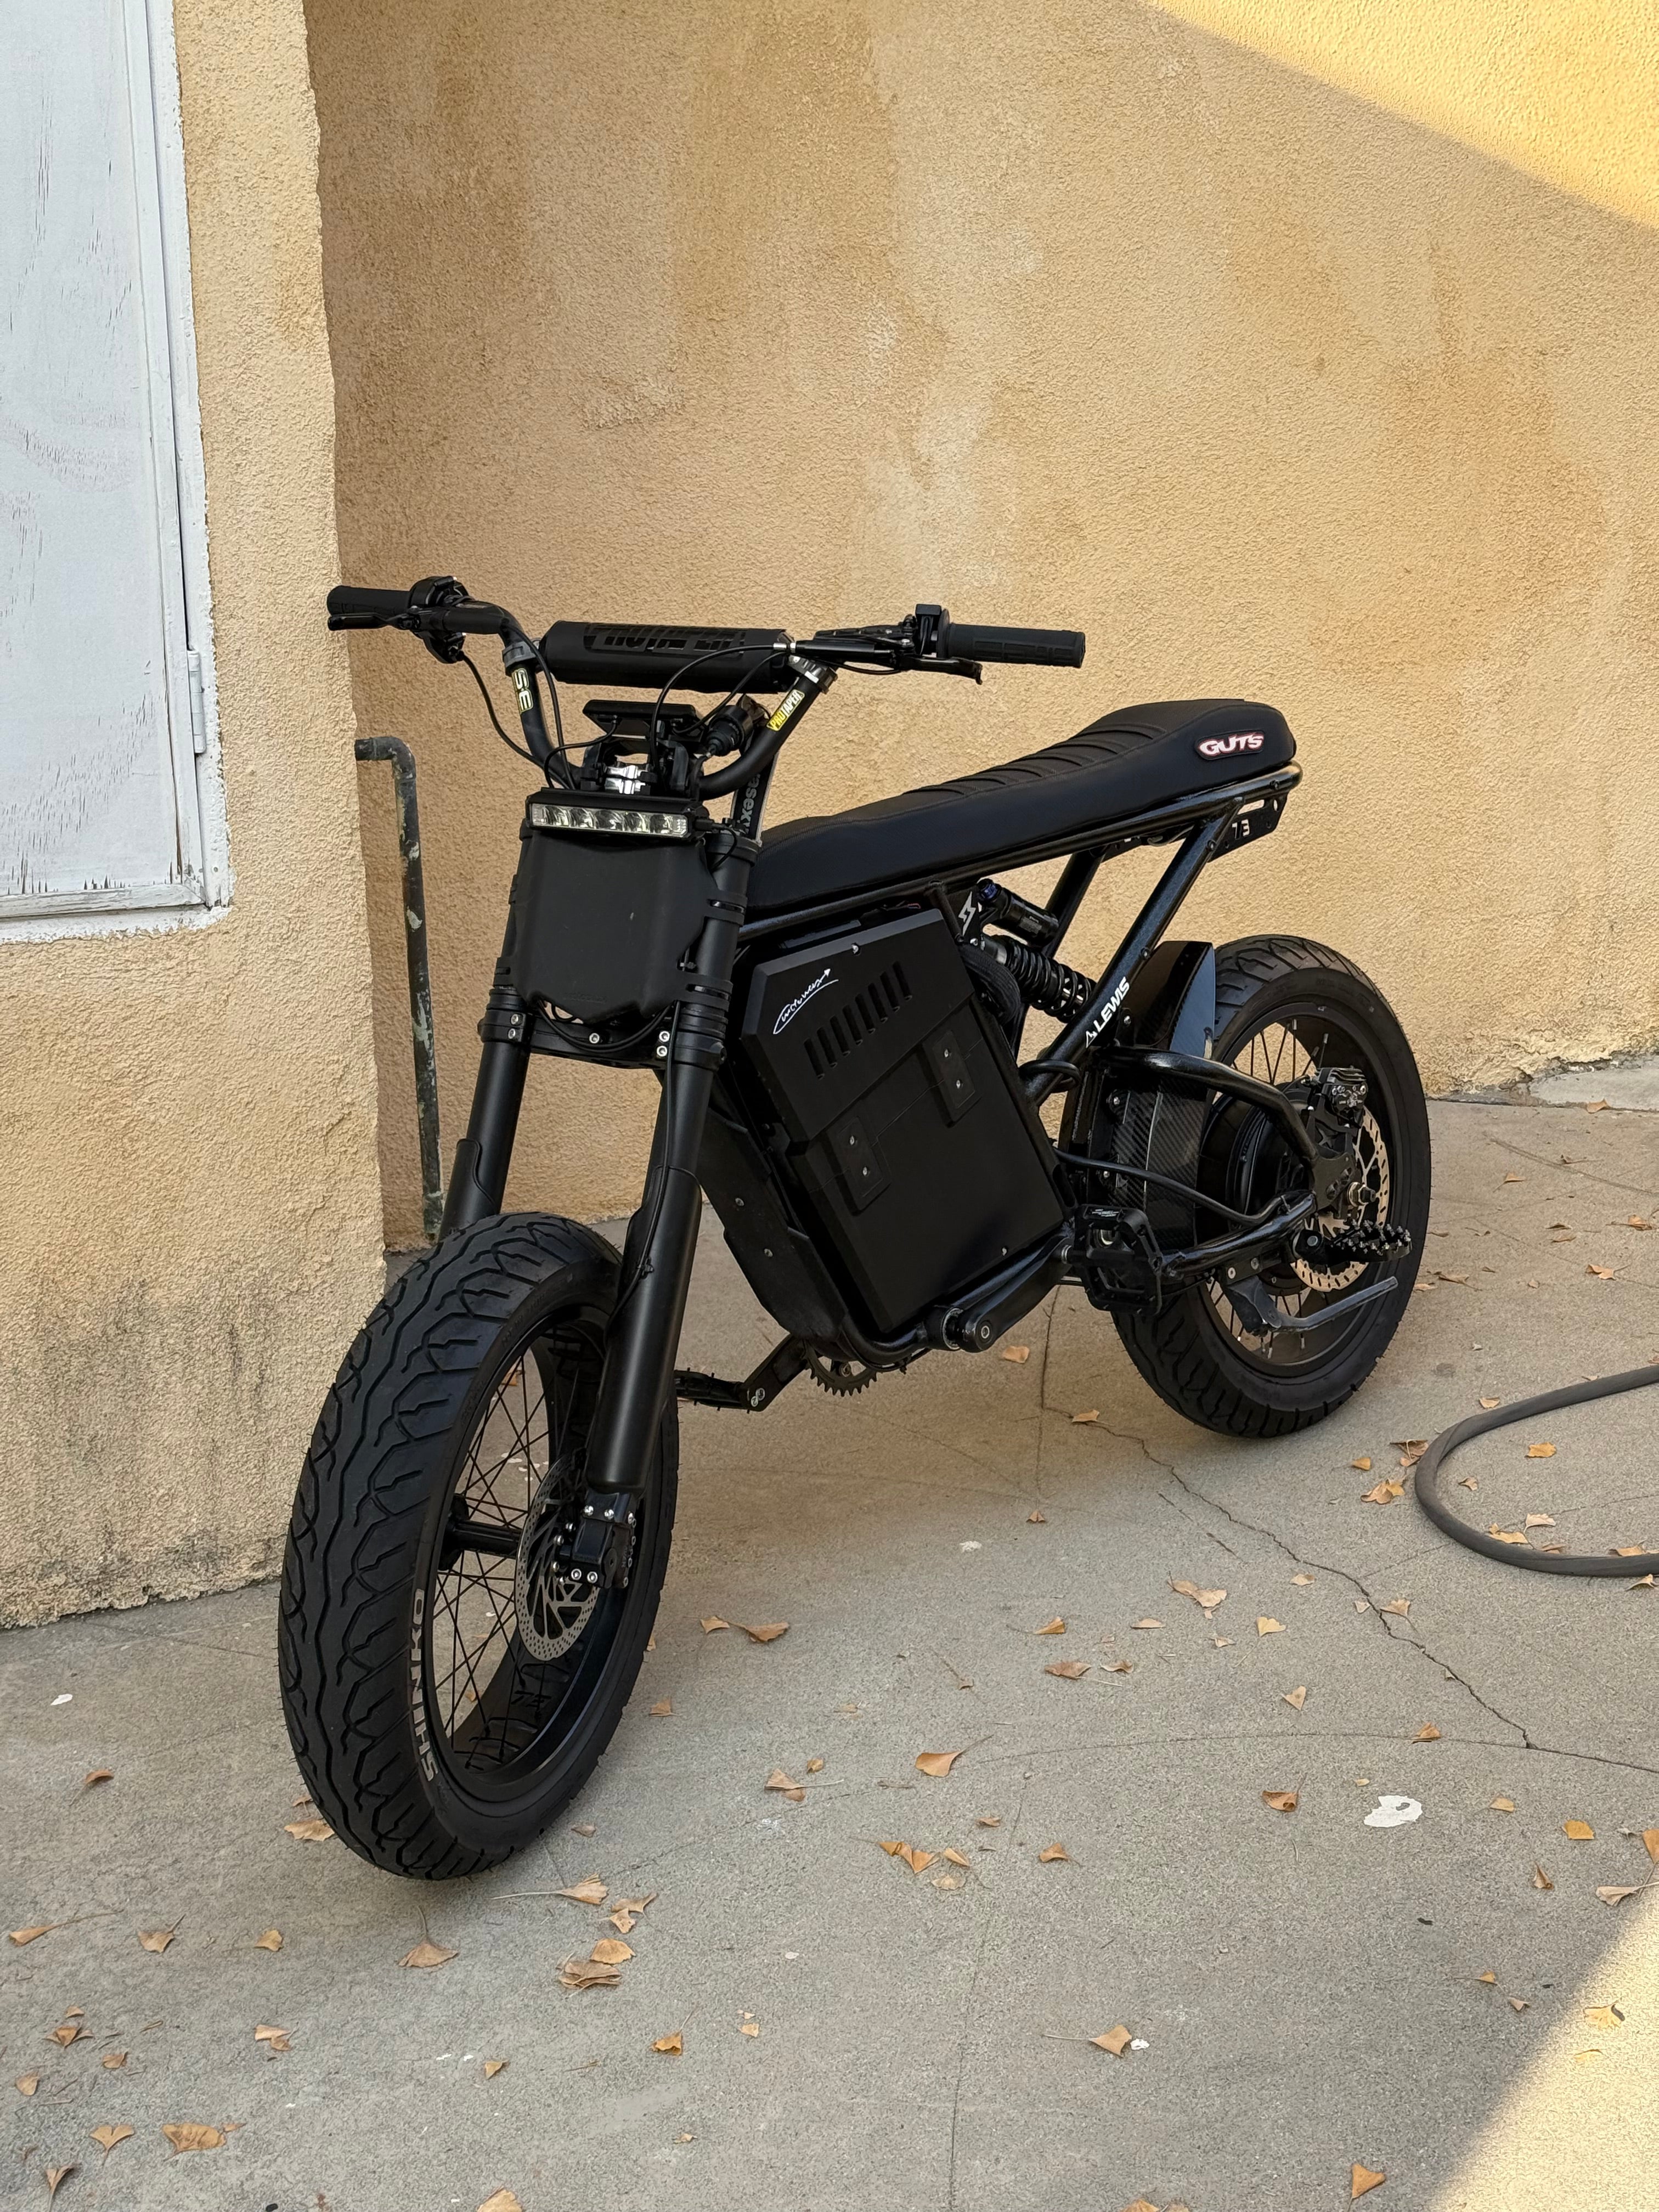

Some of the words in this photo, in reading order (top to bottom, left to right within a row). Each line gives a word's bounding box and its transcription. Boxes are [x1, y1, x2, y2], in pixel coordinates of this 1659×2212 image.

[769, 690, 803, 731] PROTAPER
[1199, 732, 1264, 756] GUTS
[1093, 977, 1130, 1032] LEWIS
[410, 1588, 438, 1781] SHINKO
